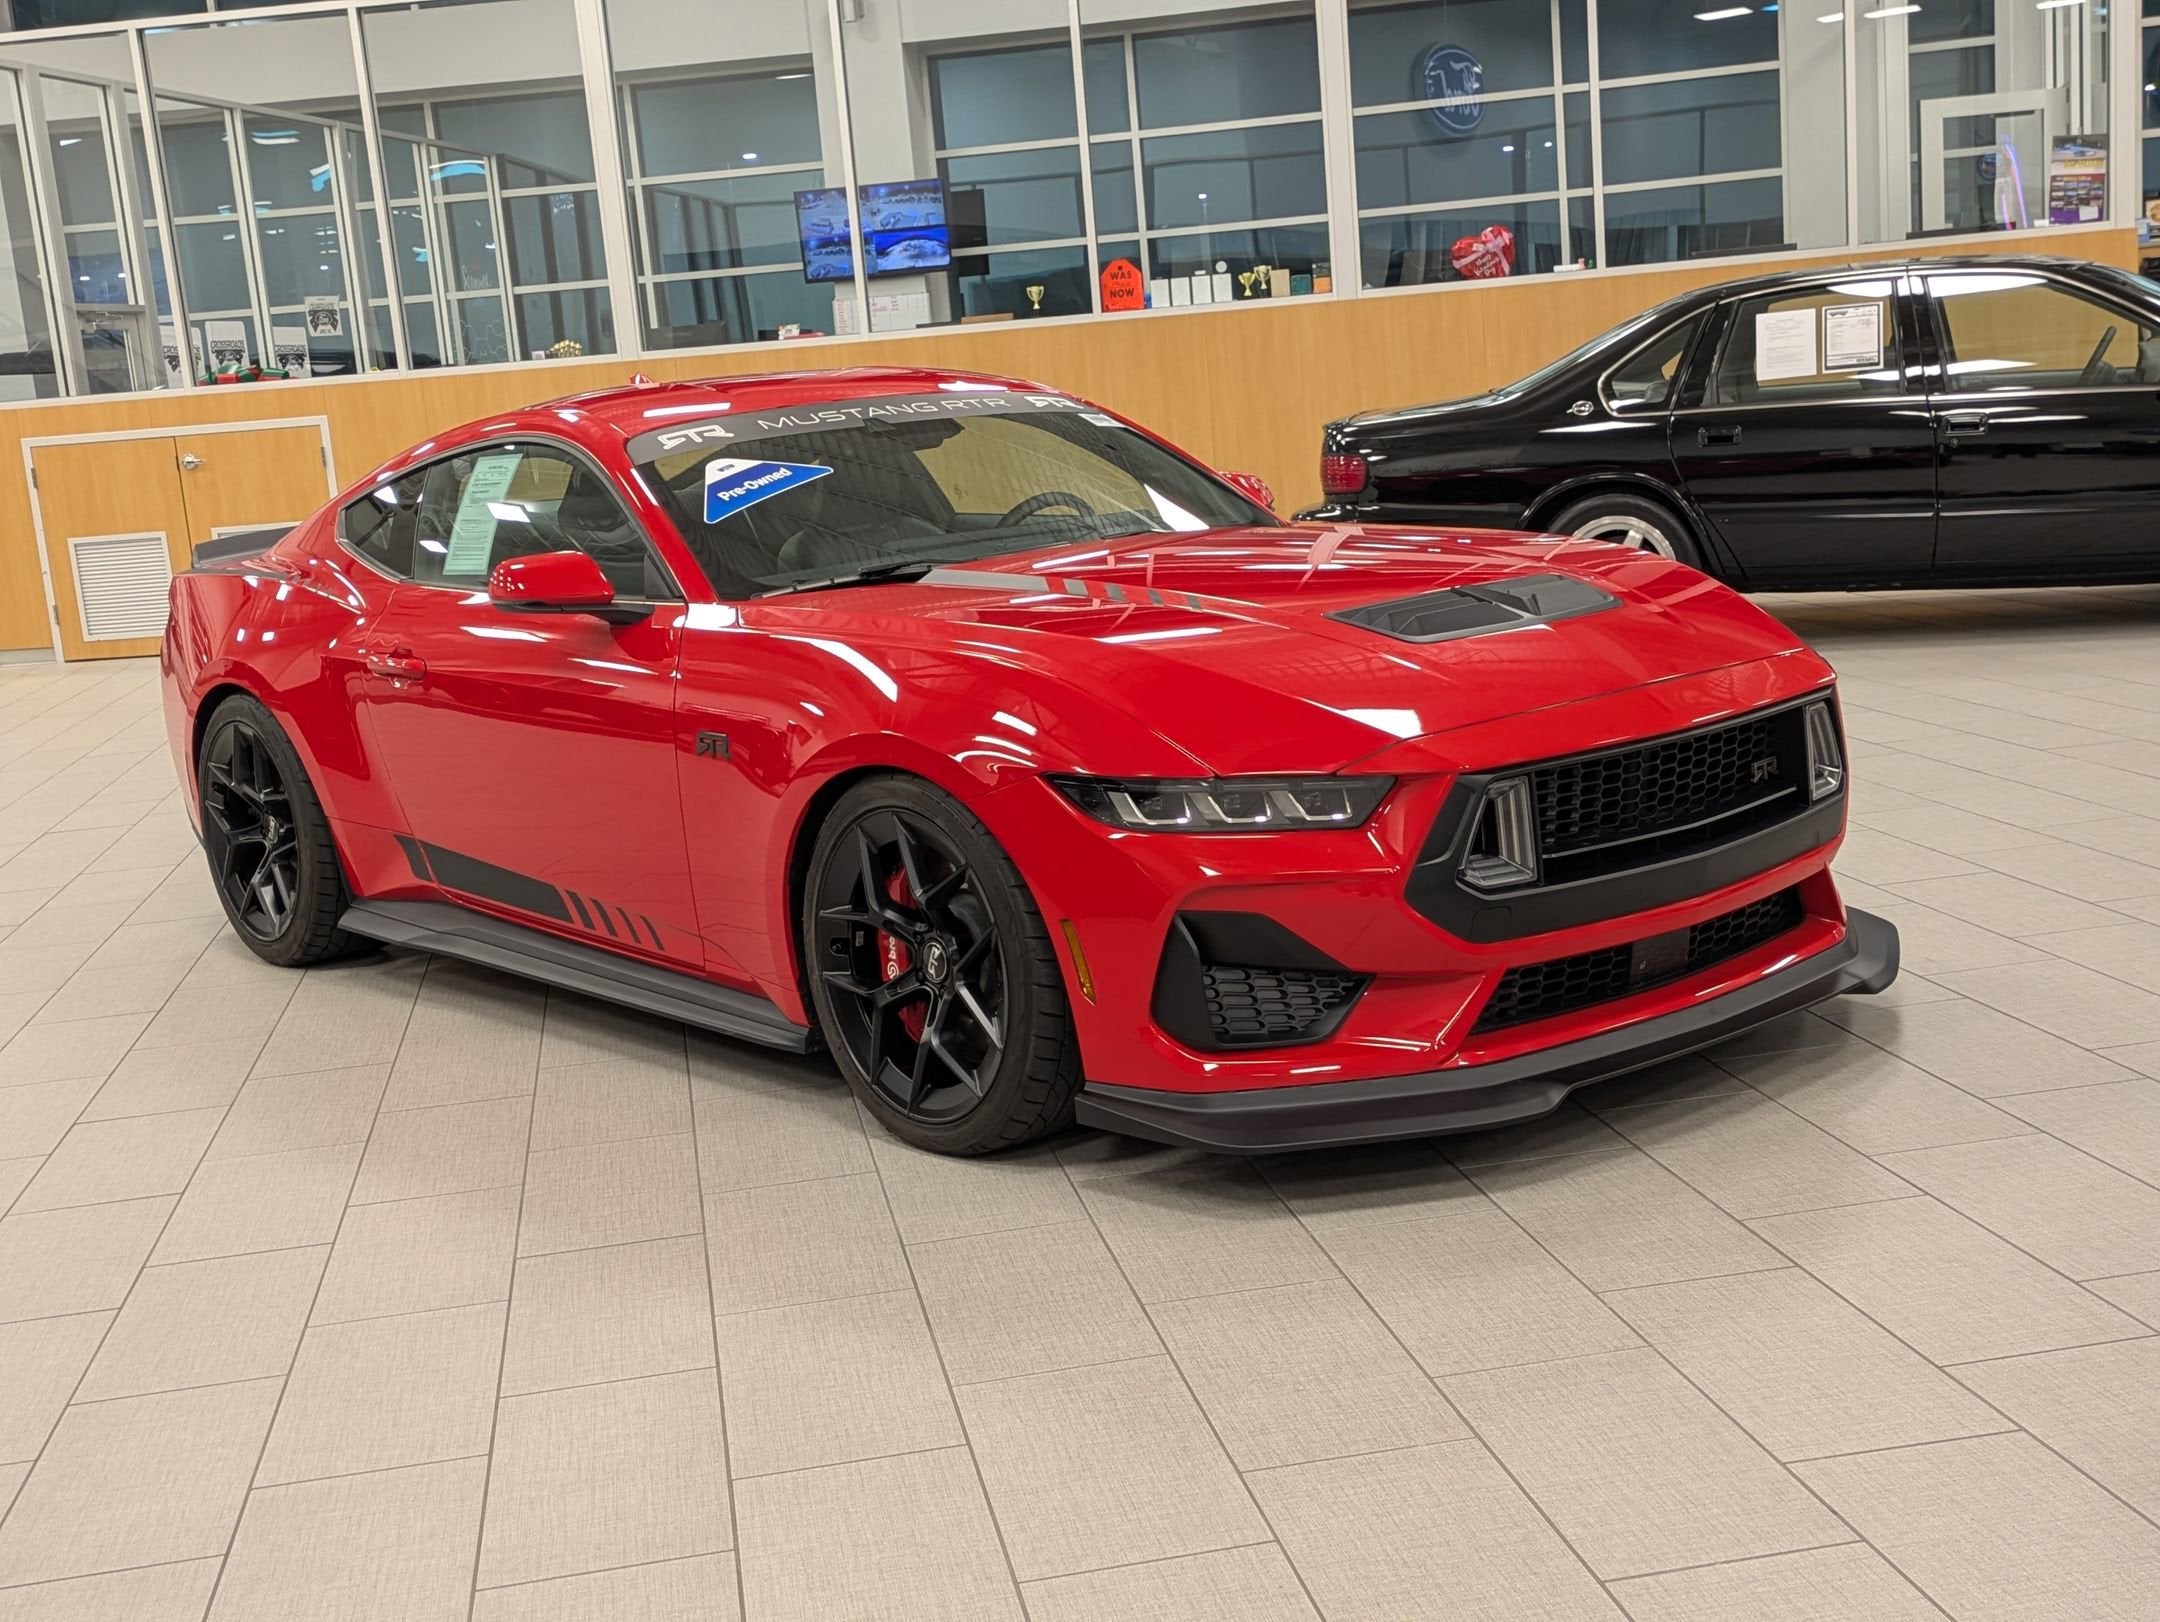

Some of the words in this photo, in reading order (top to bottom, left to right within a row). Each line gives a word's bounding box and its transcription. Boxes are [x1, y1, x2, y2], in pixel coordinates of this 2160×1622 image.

[1110, 271, 1132, 280] WAS
[1109, 288, 1135, 299] NOW
[211, 340, 244, 349] CROSSROADS
[757, 401, 938, 430] MUSTANG
[941, 398, 1010, 411] RTR
[717, 467, 793, 501] Pre-Owned
